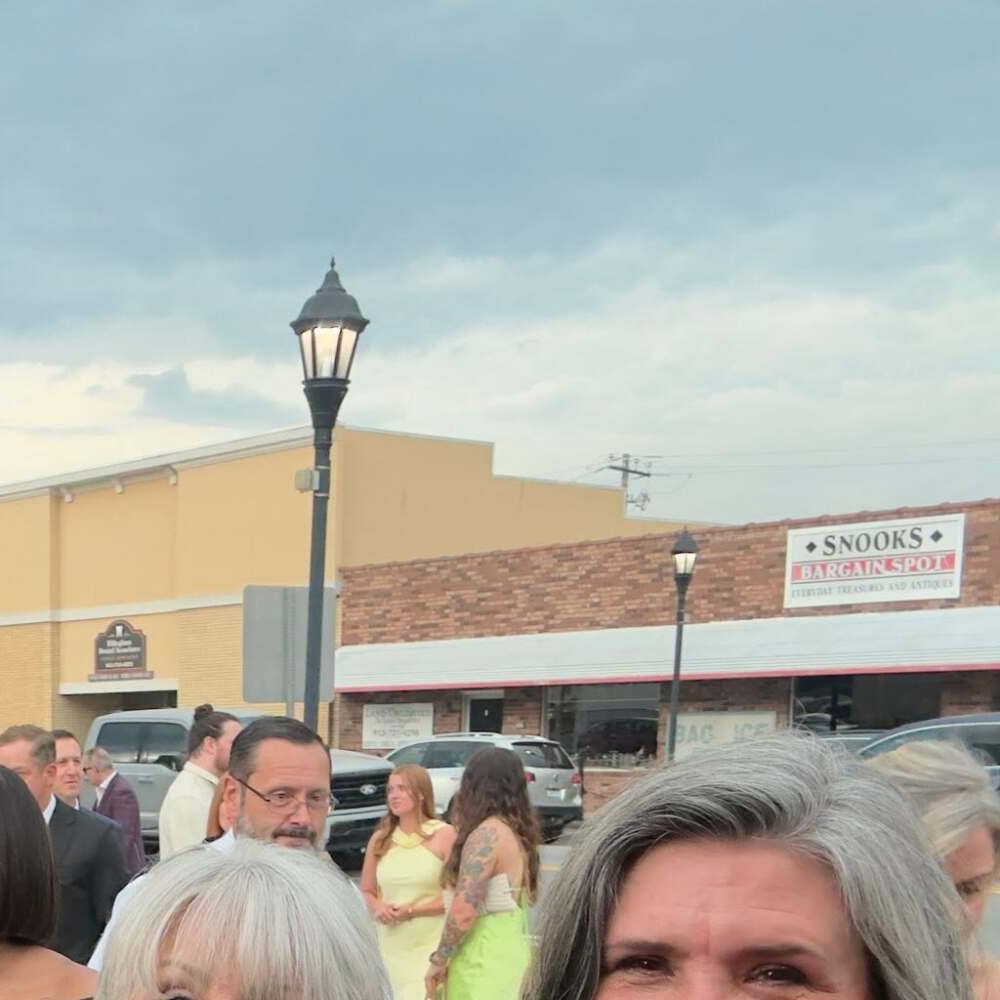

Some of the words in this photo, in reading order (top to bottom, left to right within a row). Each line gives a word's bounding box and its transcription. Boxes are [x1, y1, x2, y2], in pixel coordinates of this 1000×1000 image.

[822, 527, 923, 556] SNOOKS
[800, 558, 889, 580] BARGAIN
[891, 555, 947, 574] SPOT
[791, 586, 833, 599] EVERYDAY
[837, 583, 884, 595] TREASURES
[888, 581, 907, 592] AND
[911, 579, 953, 592] ANTIQUES
[676, 723, 713, 744] BAG
